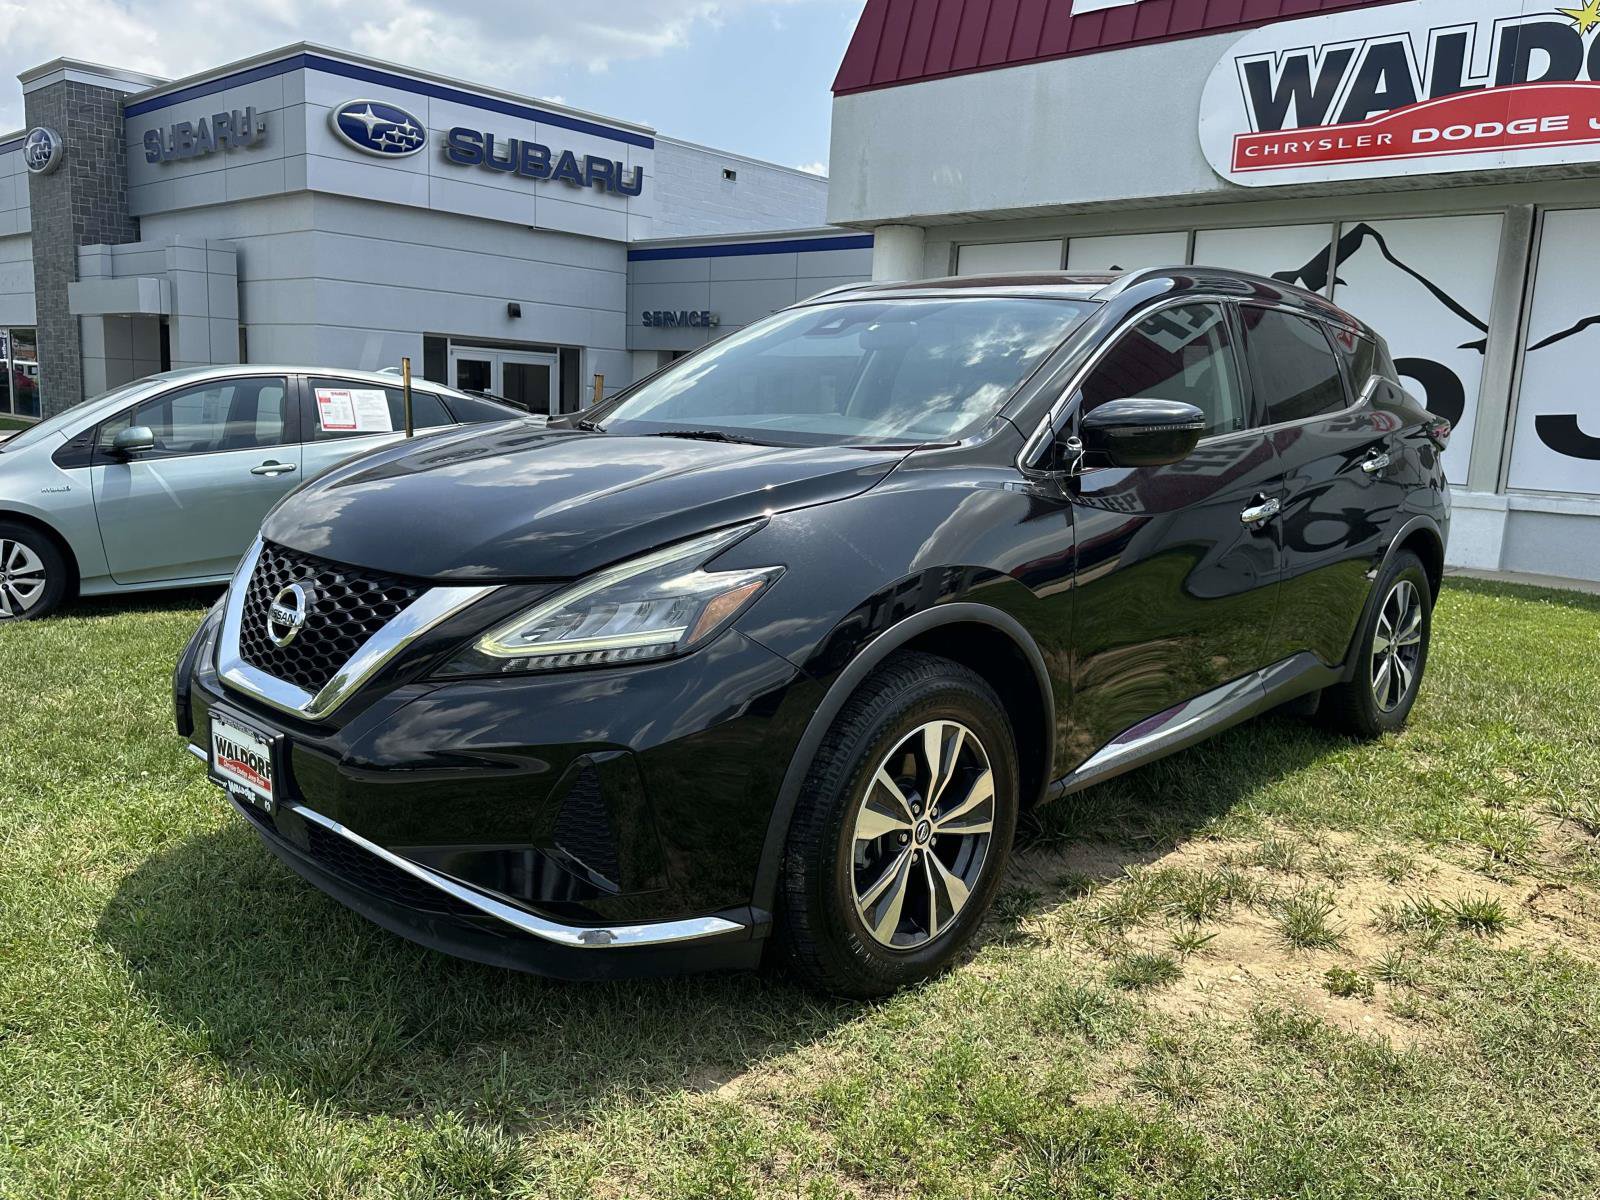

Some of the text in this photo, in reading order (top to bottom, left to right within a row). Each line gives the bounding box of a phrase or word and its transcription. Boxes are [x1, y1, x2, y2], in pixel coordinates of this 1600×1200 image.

[1238, 18, 1600, 134] WALD
[143, 106, 257, 164] SUBARU
[447, 126, 644, 196] SUBARU
[1244, 133, 1394, 157] CHRYSLER
[1411, 115, 1570, 144] DODGE
[642, 310, 711, 328] SERVICE
[214, 735, 272, 781] WALDORF
